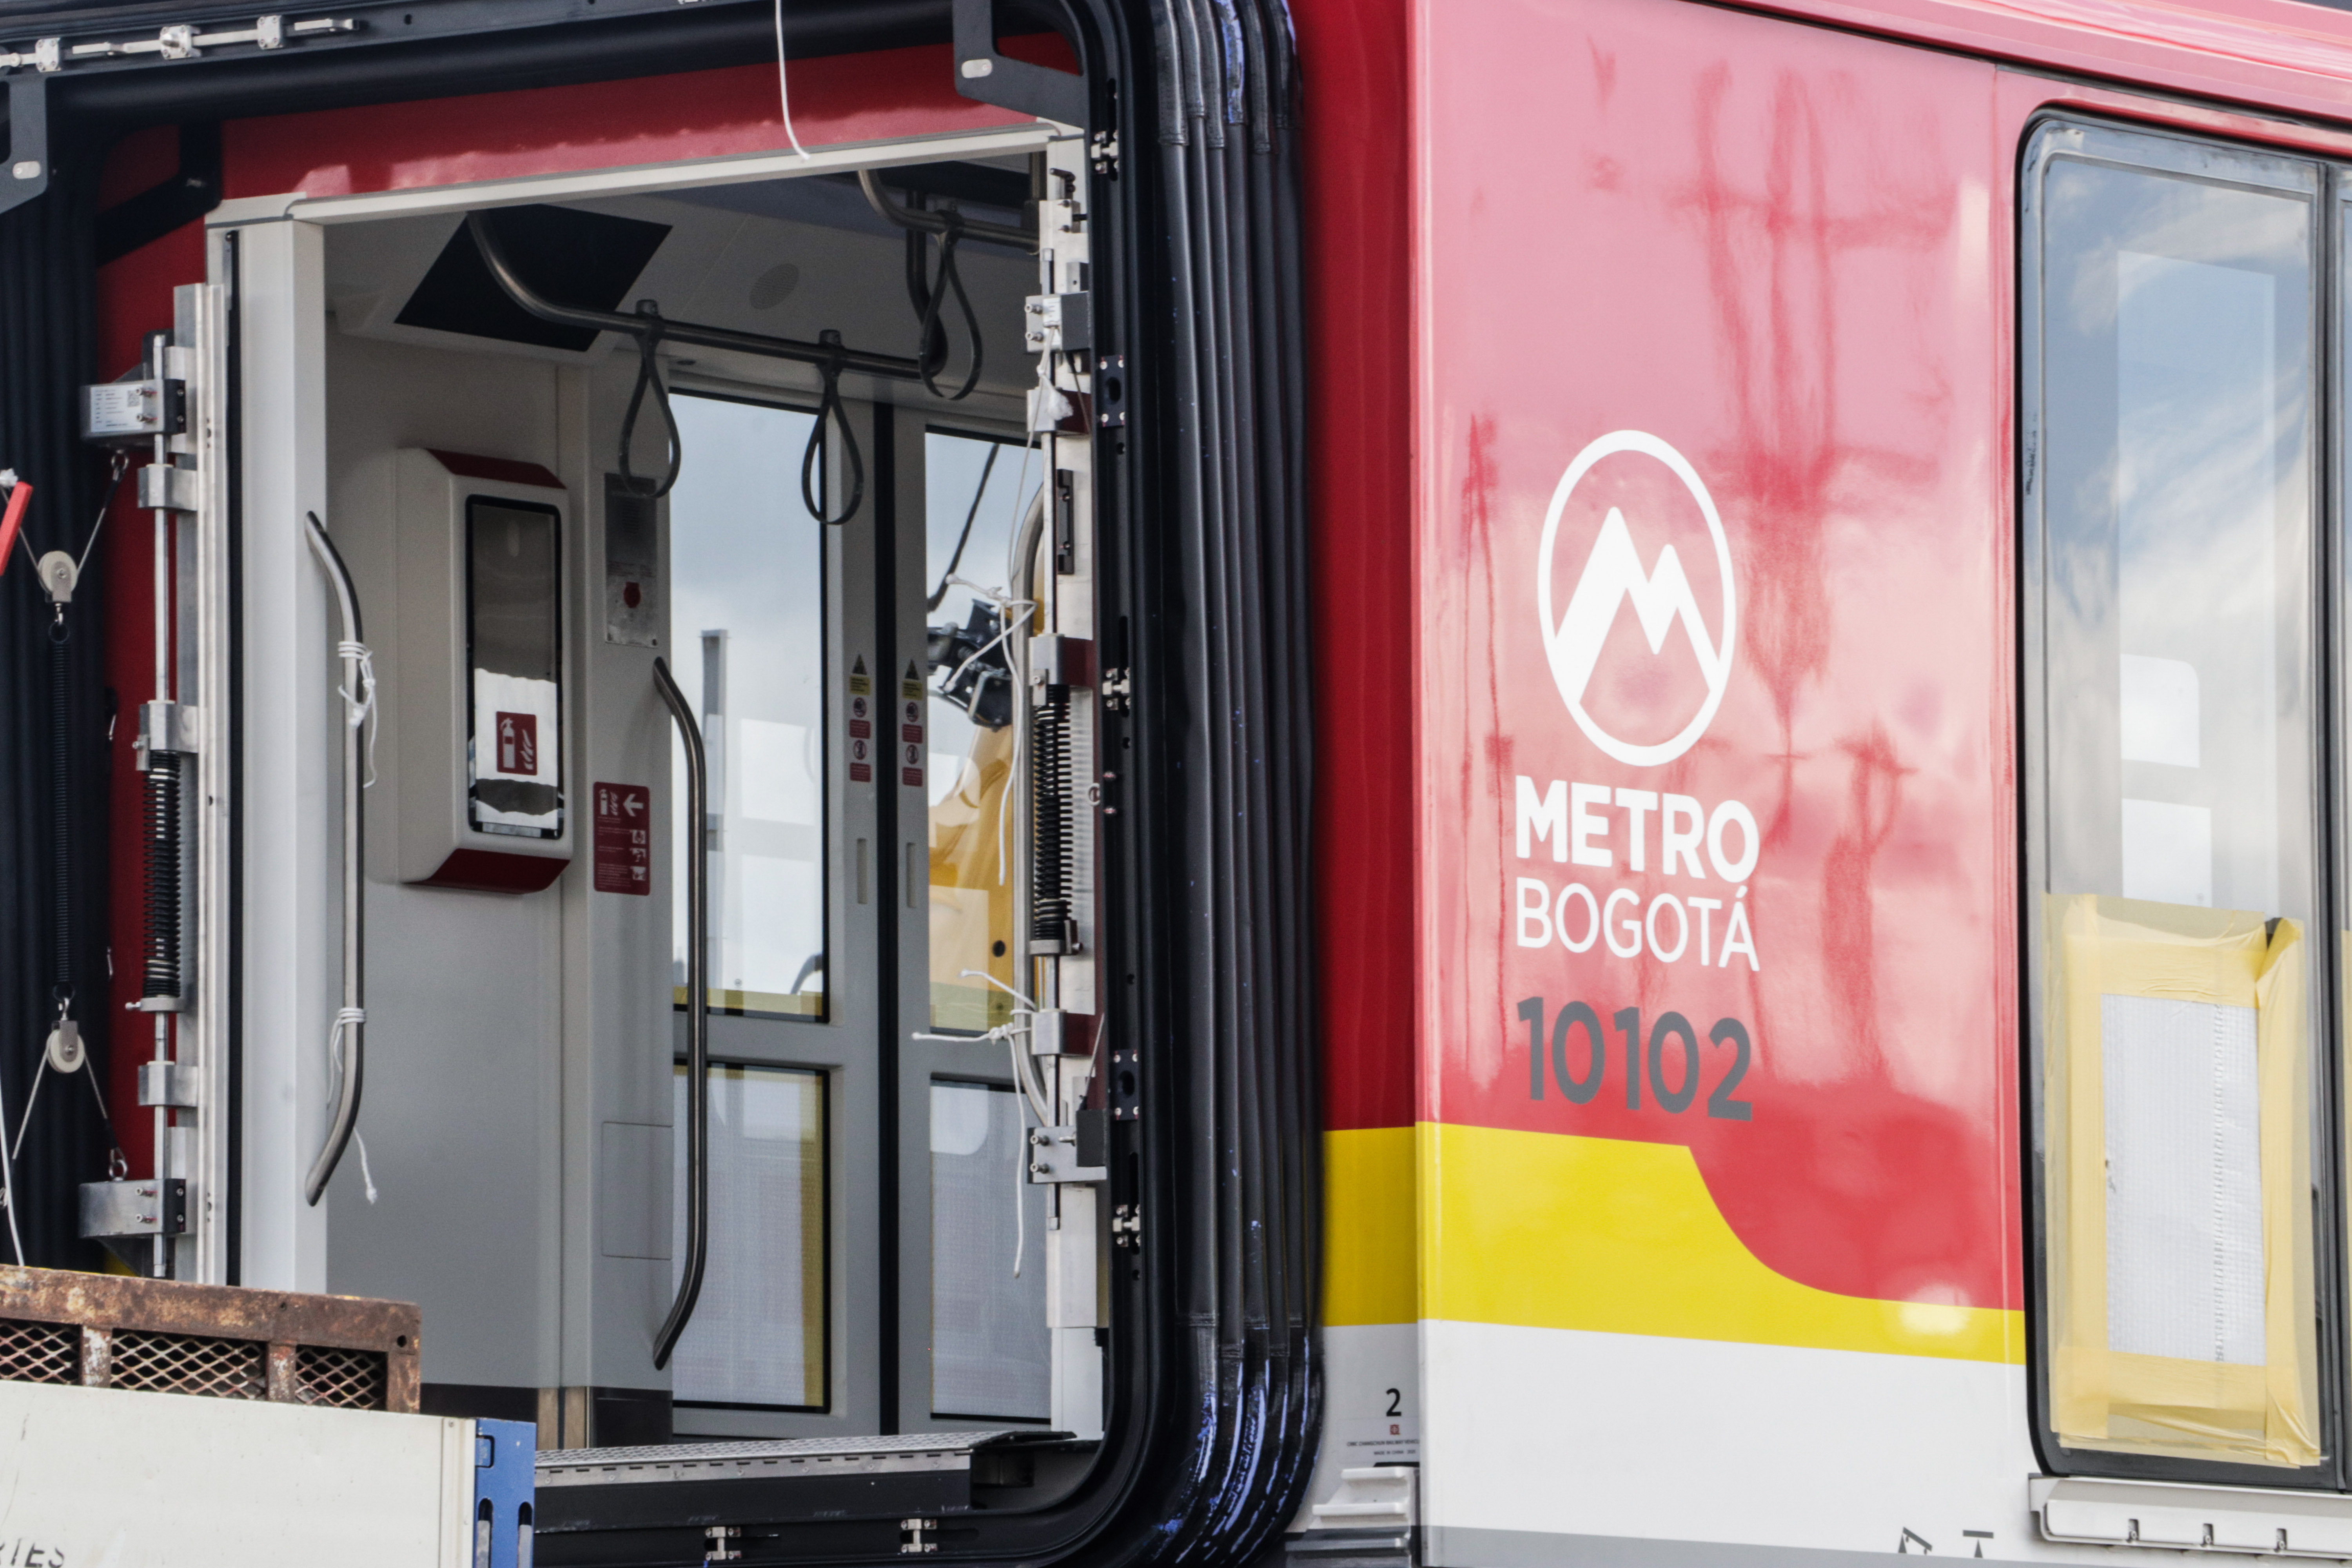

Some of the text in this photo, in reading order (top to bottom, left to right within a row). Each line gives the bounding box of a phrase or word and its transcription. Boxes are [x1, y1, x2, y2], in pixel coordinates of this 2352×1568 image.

[1515, 775, 1760, 883] METRO
[1516, 876, 1760, 971] BOGOTÁ
[1517, 996, 1753, 1121] 10102
[1386, 1388, 1402, 1417] 2
